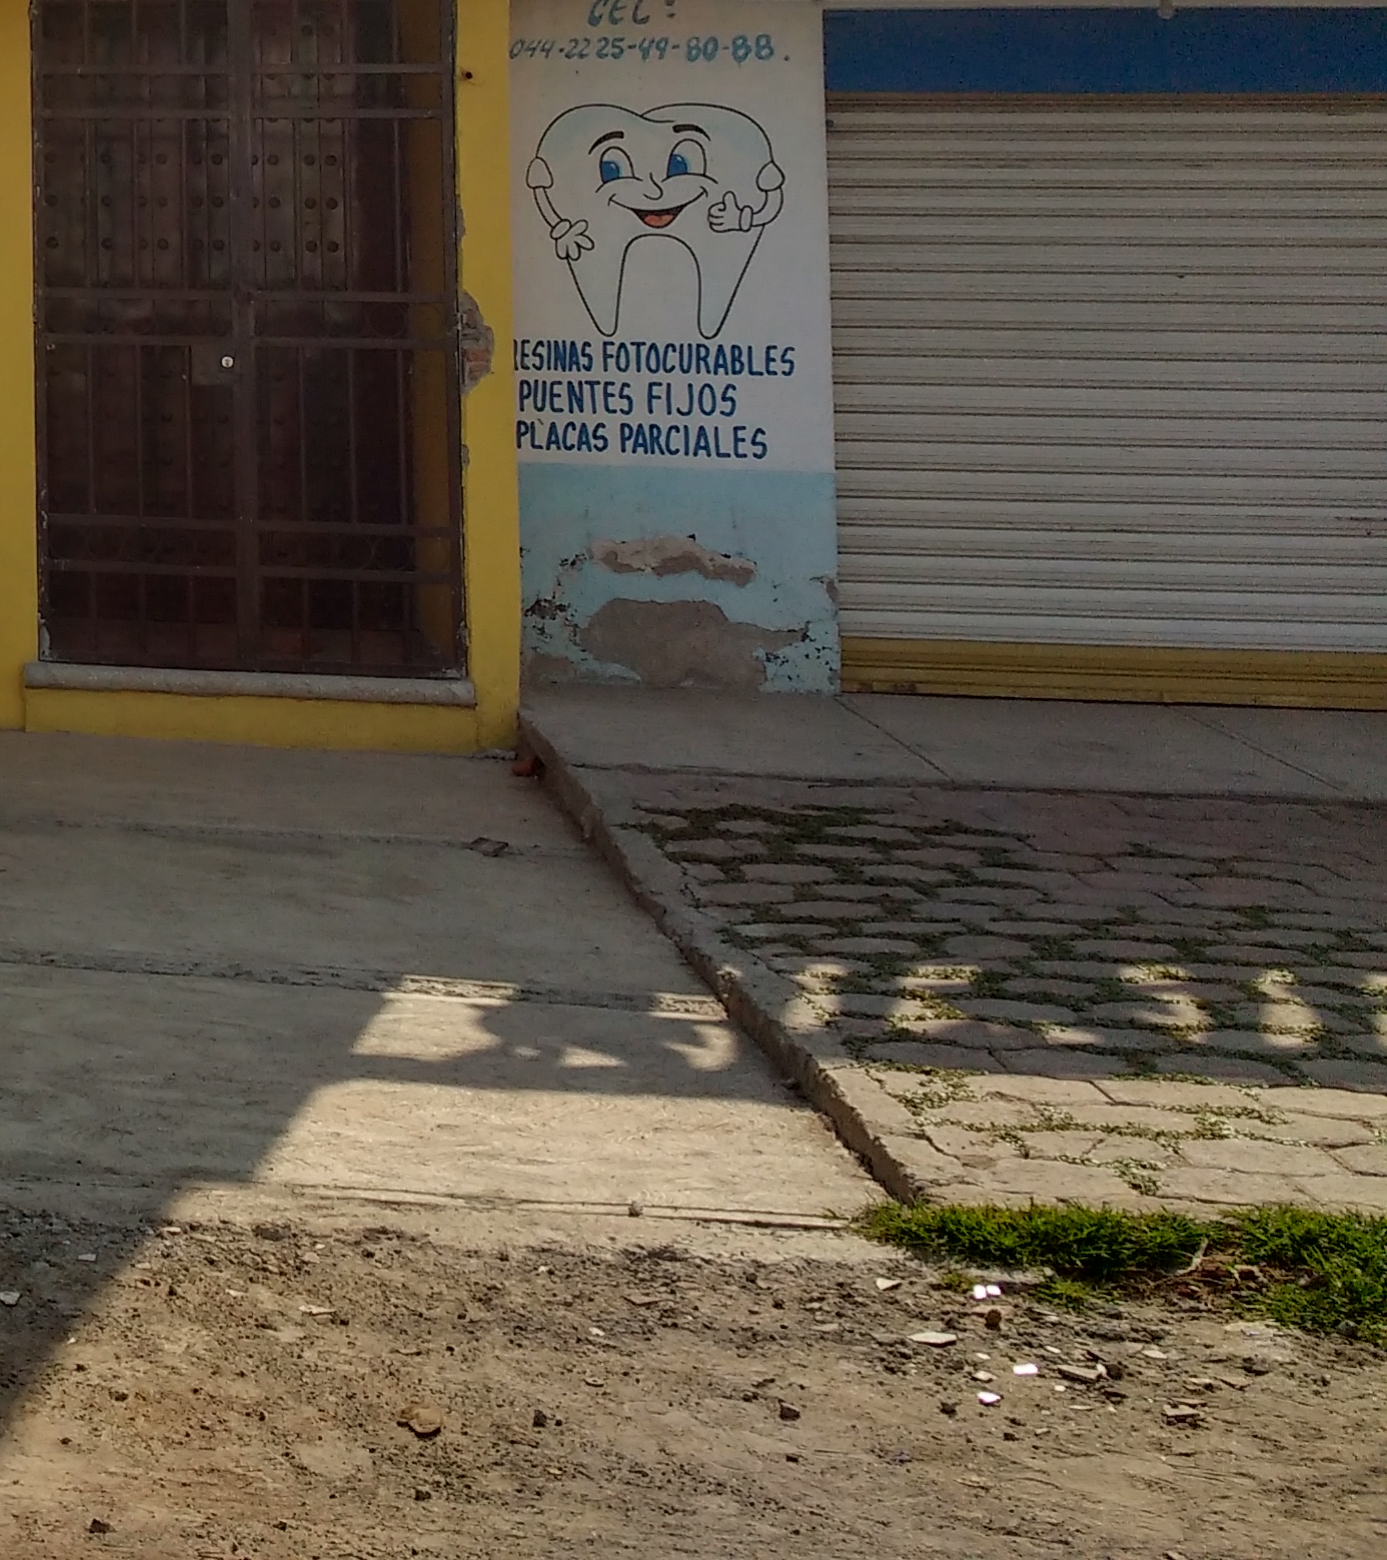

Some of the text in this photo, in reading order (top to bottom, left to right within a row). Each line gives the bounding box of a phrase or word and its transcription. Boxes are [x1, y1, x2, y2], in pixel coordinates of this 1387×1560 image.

[603, 340, 796, 377] FOTOCURABLES
[518, 379, 738, 417] PUENTES FIJOS
[515, 419, 769, 459] PLACAS PARCIALES
